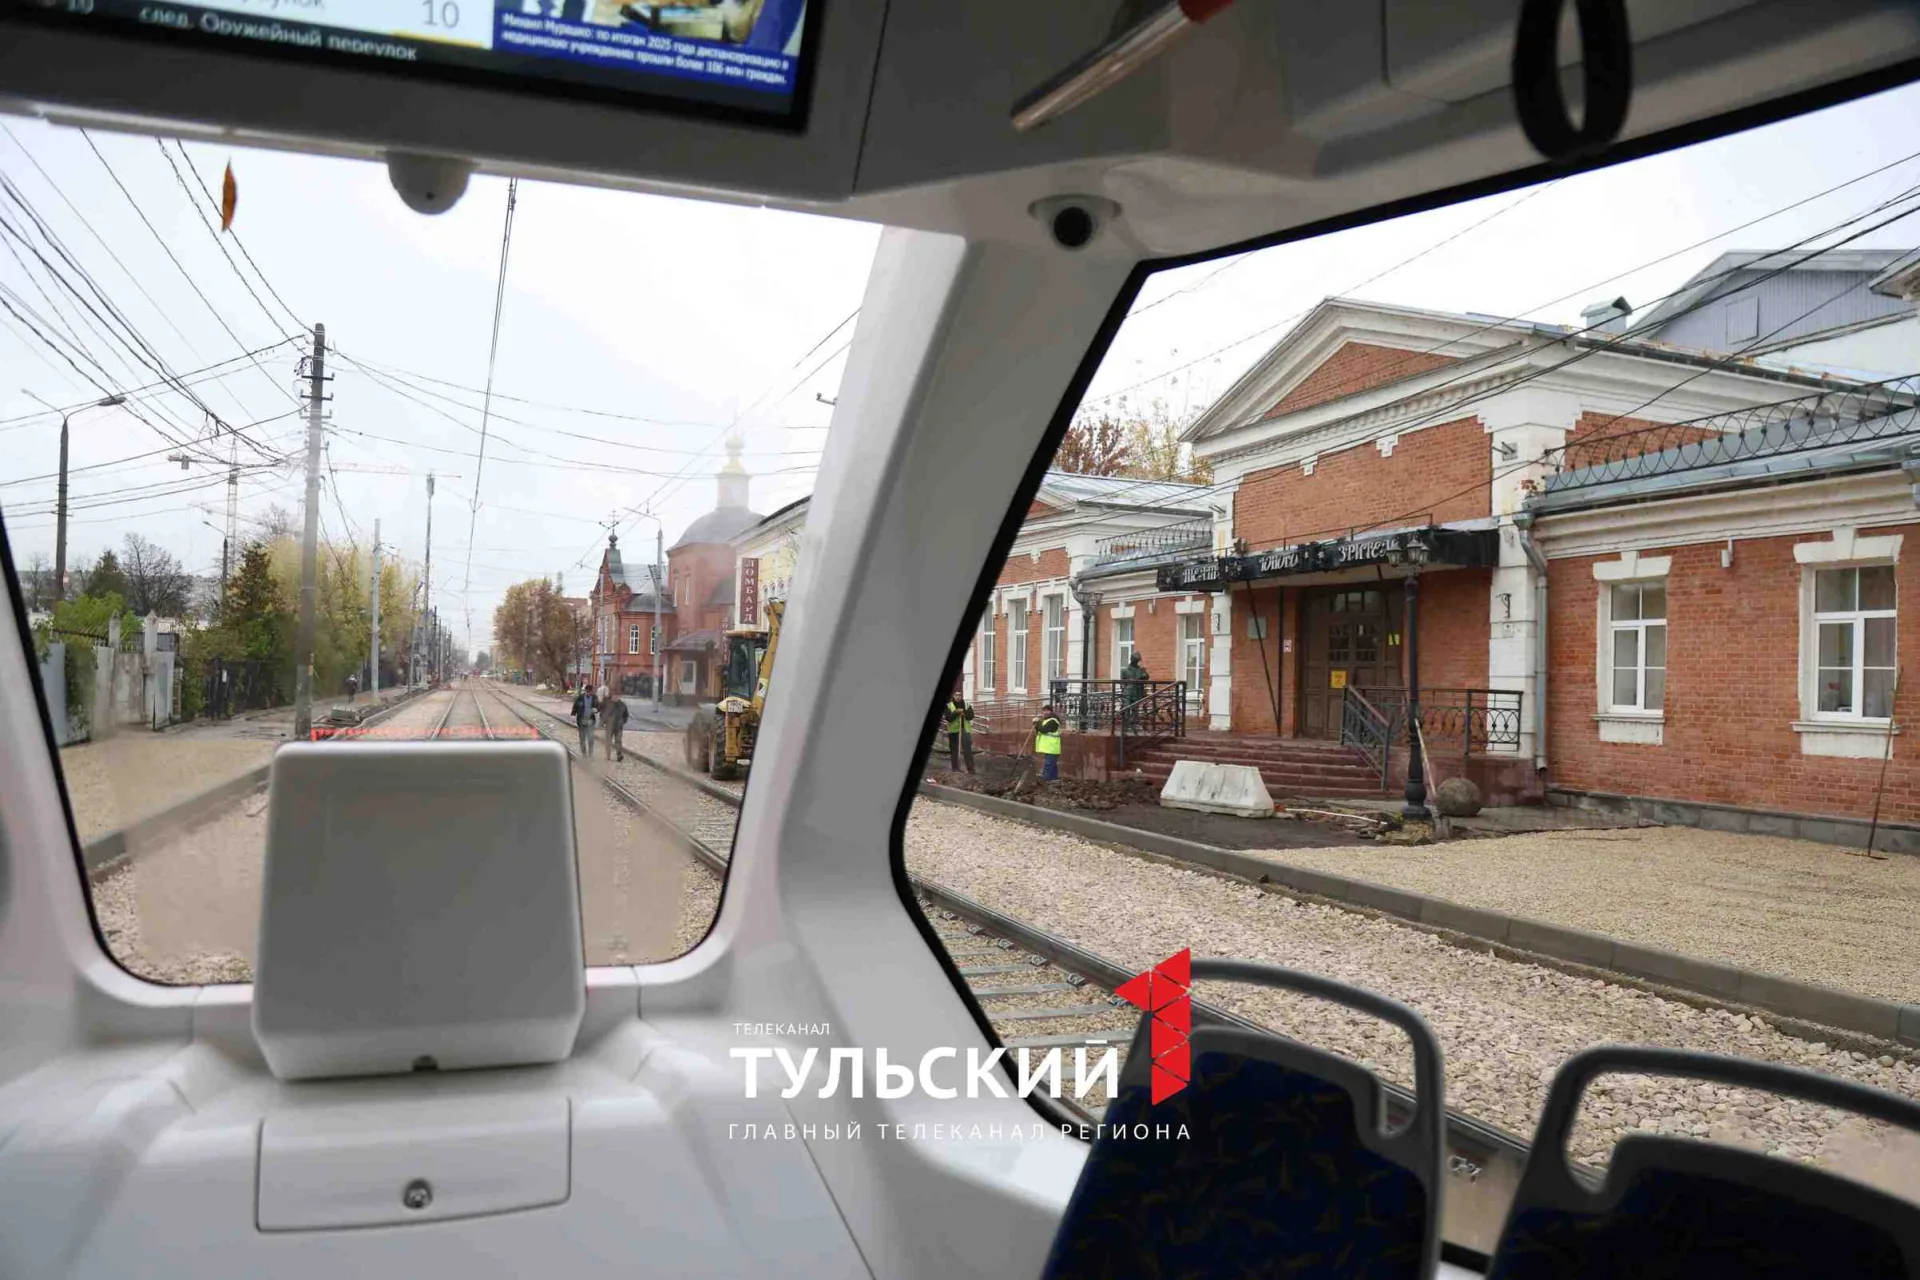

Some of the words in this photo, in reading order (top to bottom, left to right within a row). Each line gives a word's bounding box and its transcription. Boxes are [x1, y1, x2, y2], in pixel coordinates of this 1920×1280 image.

[139, 7, 195, 29] след.
[201, 12, 322, 48] Оружейный
[328, 34, 418, 60] переулок
[422, 0, 460, 28] 10
[743, 560, 755, 623] ЛОМБАРД
